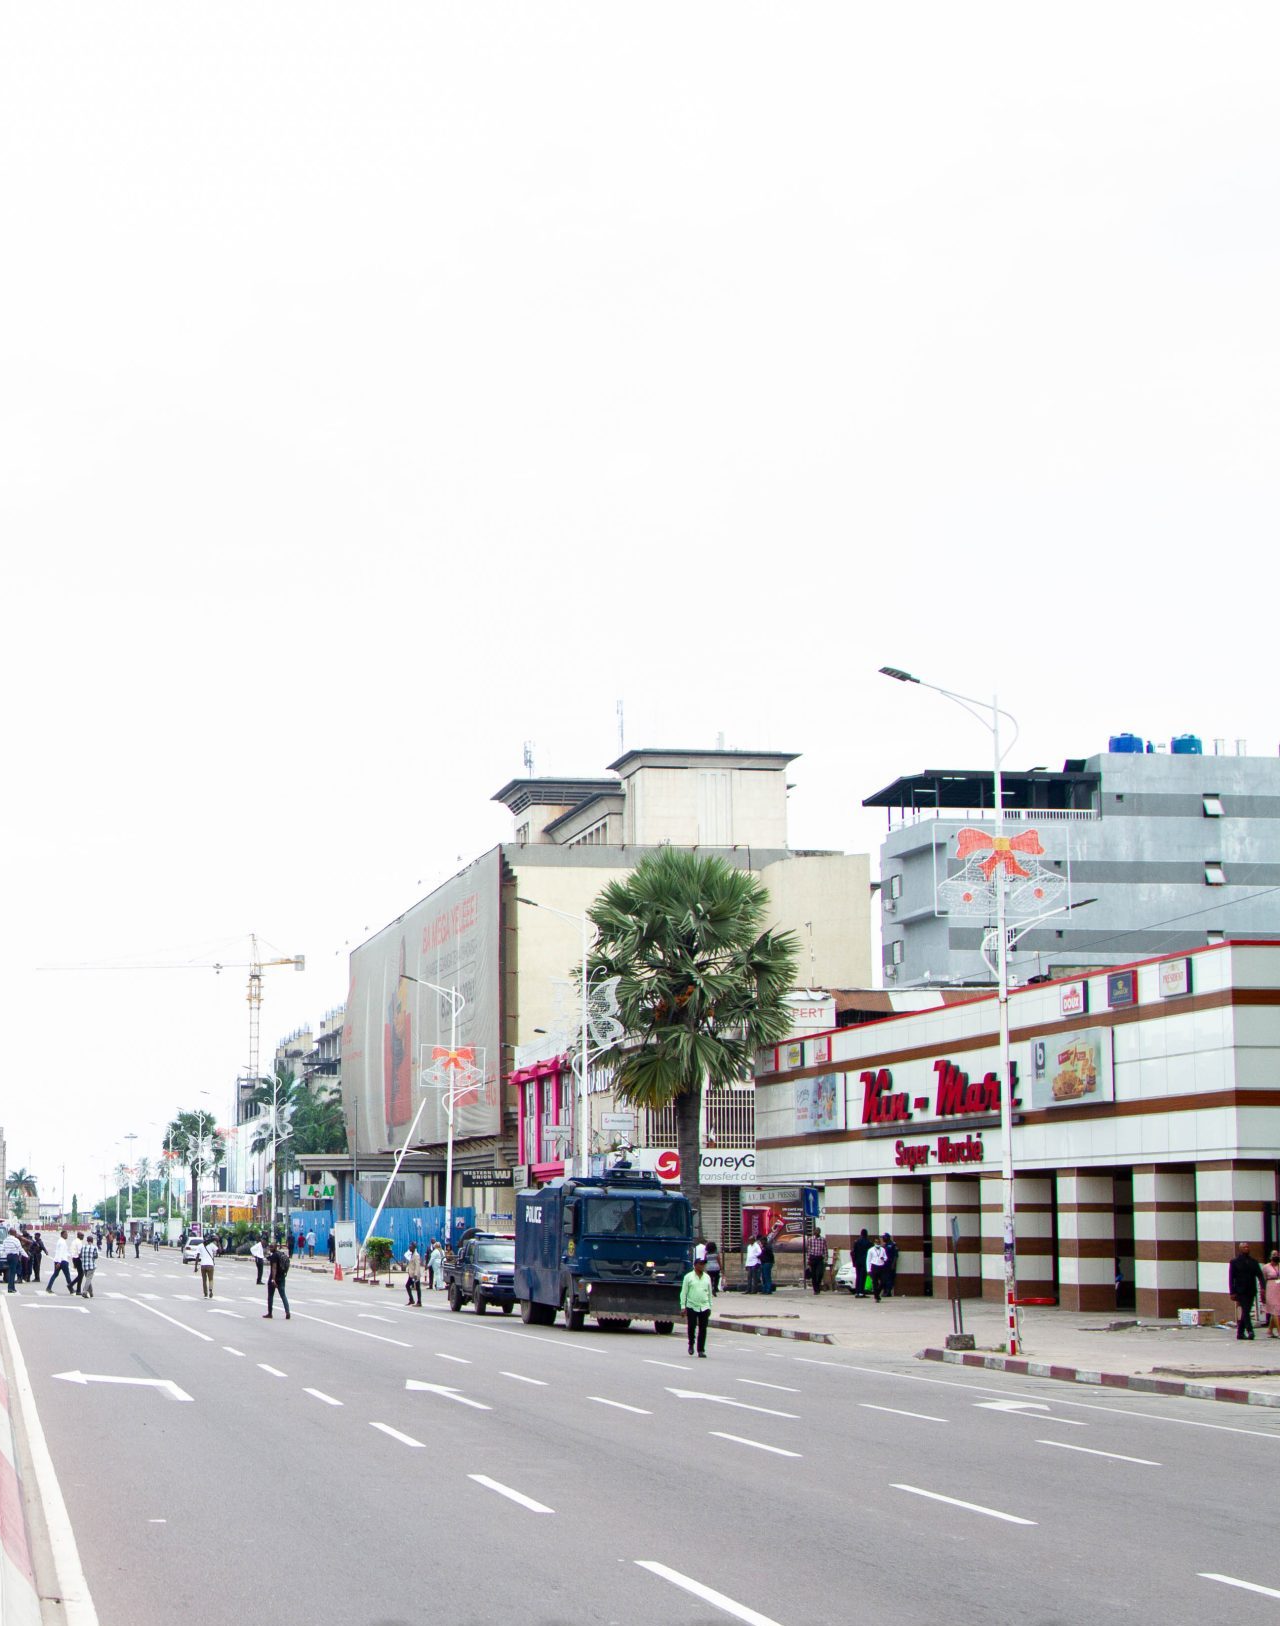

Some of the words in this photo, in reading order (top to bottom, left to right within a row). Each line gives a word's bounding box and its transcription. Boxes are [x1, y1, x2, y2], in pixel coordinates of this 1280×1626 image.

[1063, 994, 1080, 1012] DOUX
[859, 1069, 913, 1124] Kin
[699, 1153, 755, 1171] oneyG
[494, 1170, 511, 1179] WU
[700, 1172, 739, 1181] ransfert
[777, 1190, 797, 1200] PRESSE
[525, 1205, 543, 1224] POLICE
